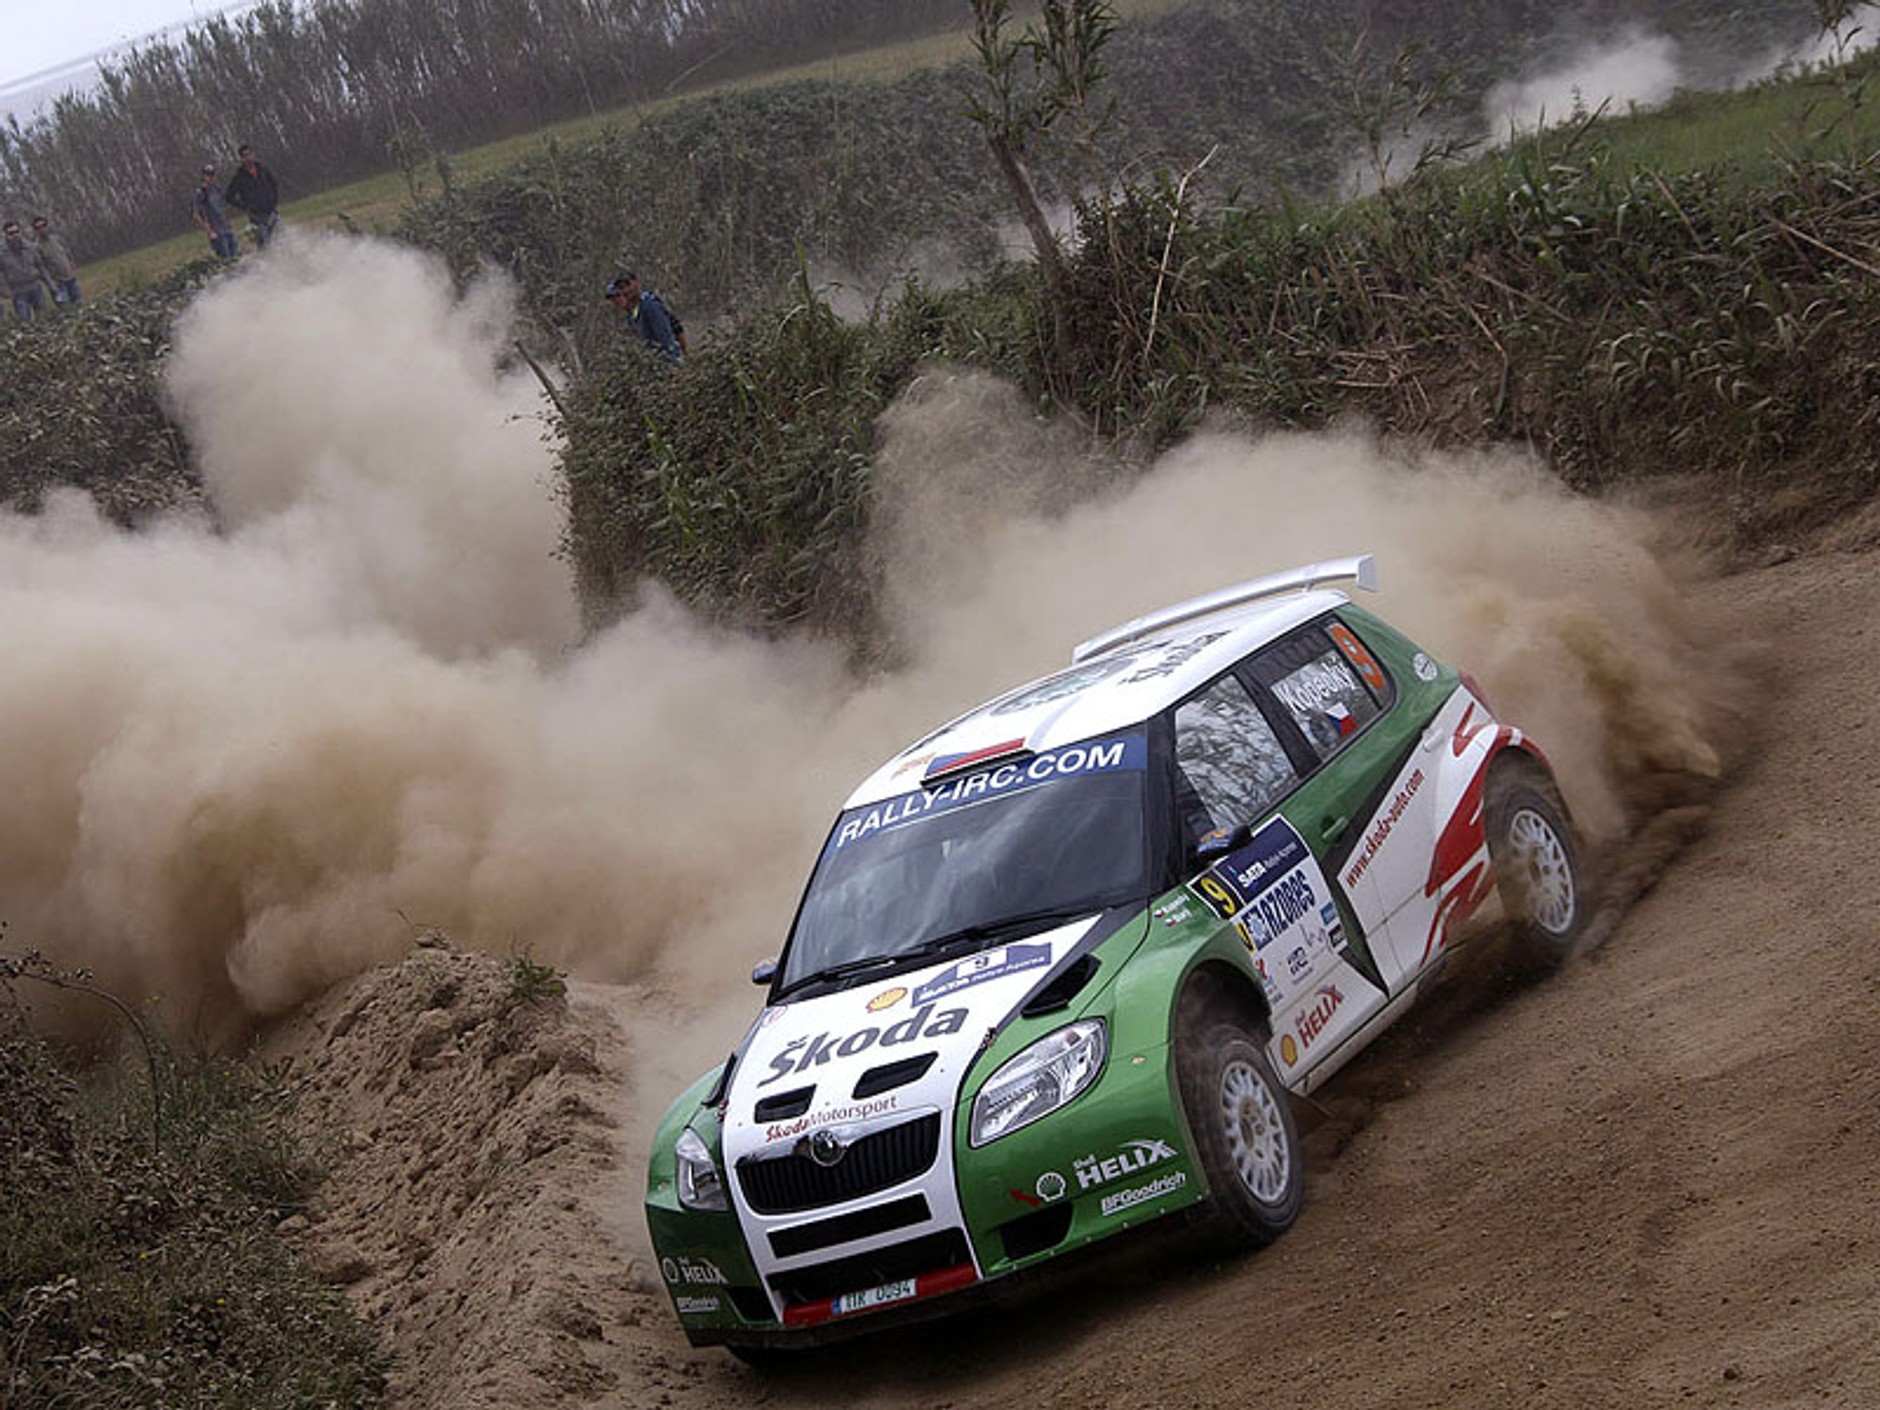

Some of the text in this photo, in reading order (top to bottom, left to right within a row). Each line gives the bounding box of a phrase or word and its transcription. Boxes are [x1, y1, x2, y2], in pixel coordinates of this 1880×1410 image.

[836, 742, 1126, 848] RALLY-IRC.COM
[1345, 768, 1425, 889] www.skoda-auto.com
[1201, 877, 1237, 917] 9
[757, 1002, 970, 1089] Škoda
[1298, 985, 1345, 1049] HELIX
[1075, 1140, 1178, 1189] HELIX
[1101, 1171, 1187, 1215] BFGoodrich
